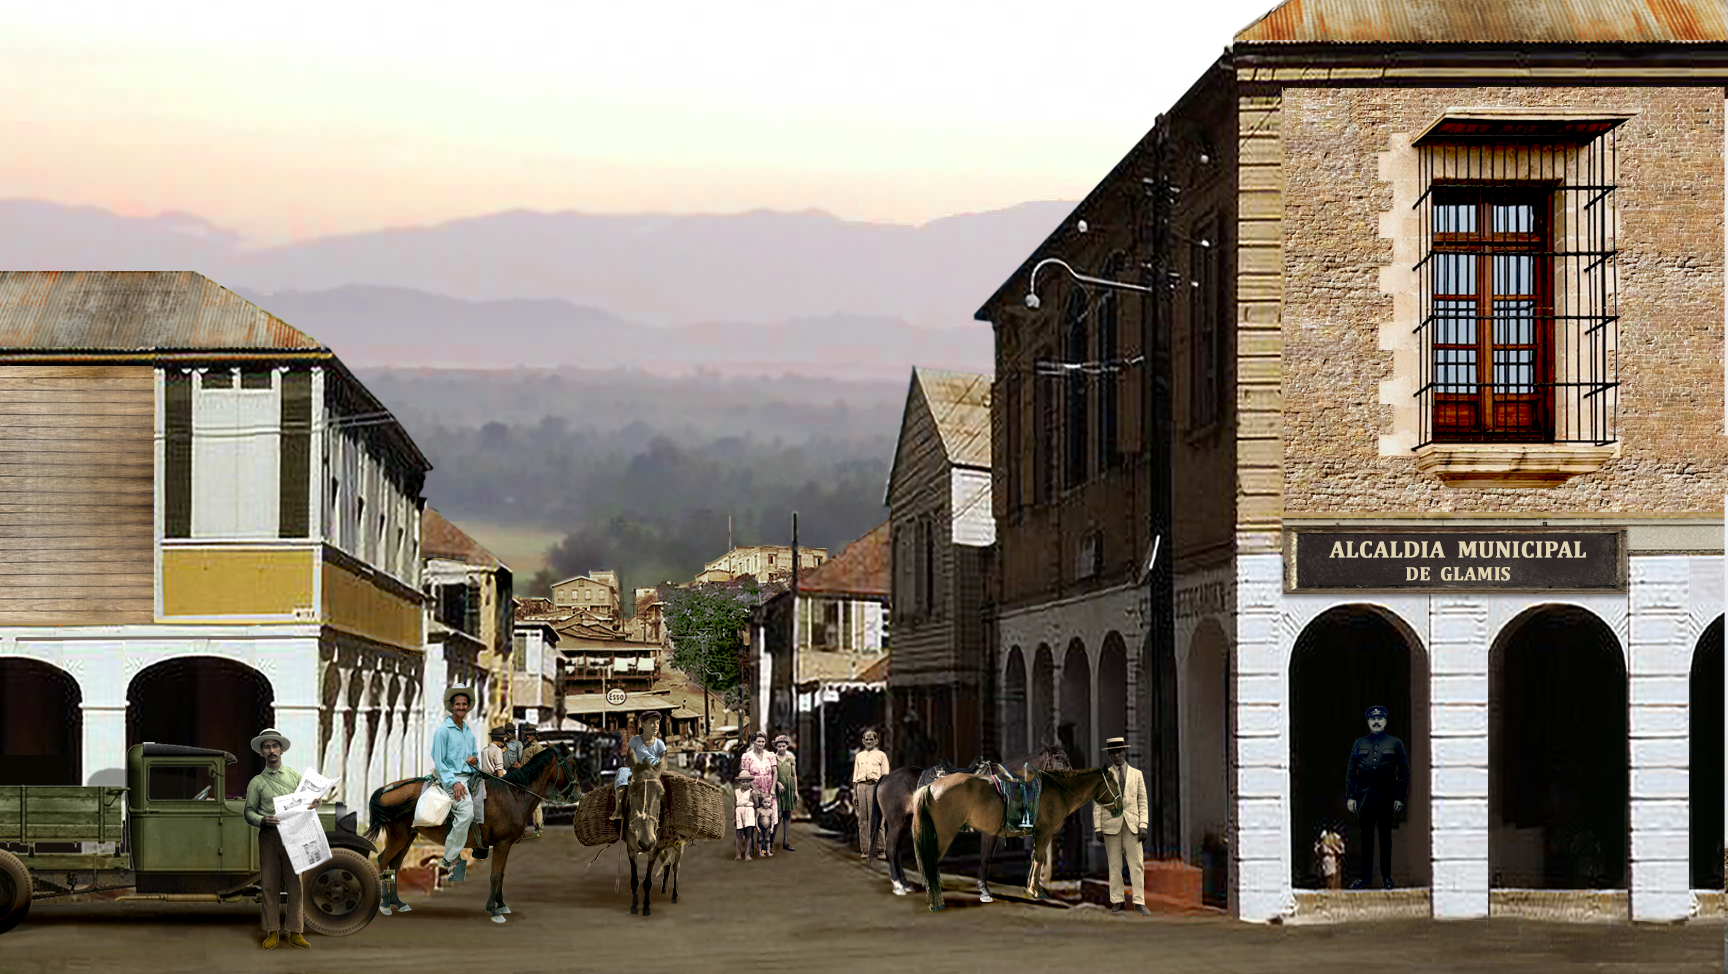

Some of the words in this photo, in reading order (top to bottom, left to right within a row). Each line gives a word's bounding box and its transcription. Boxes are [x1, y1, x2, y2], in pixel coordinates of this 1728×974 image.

[1329, 540, 1446, 559] ALCALDIA
[1457, 540, 1587, 559] MUNICIPAL
[1405, 566, 1431, 581] DE
[1440, 566, 1511, 581] GLAMIS
